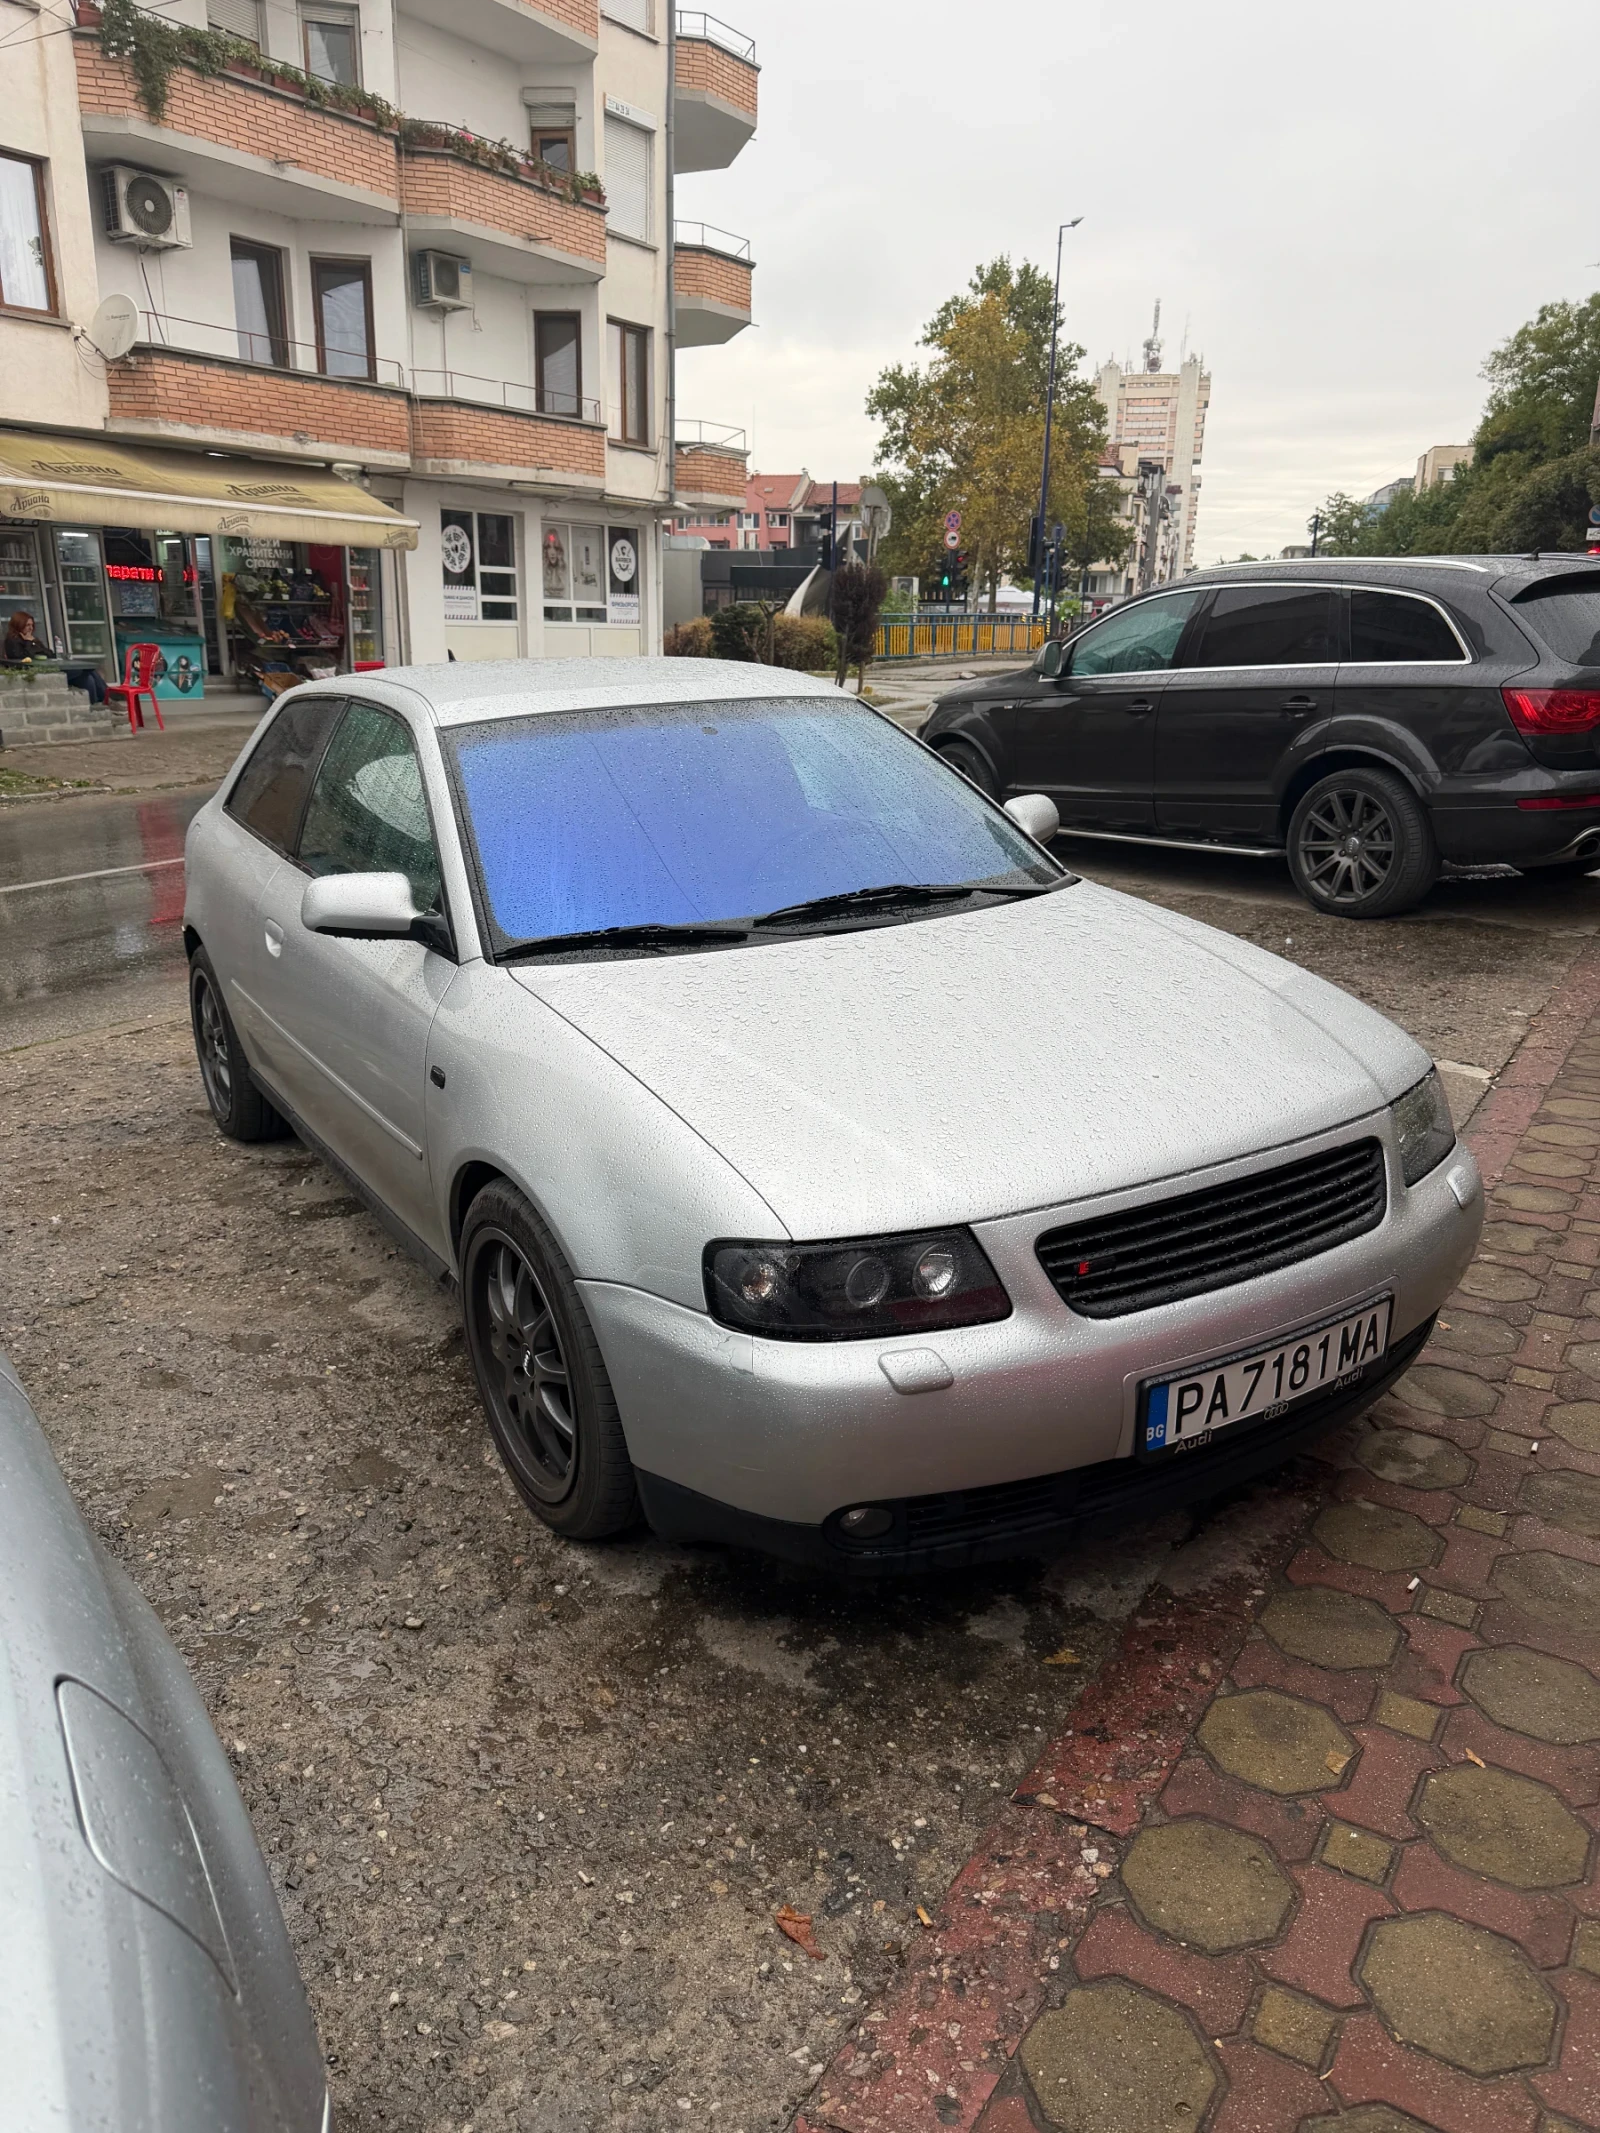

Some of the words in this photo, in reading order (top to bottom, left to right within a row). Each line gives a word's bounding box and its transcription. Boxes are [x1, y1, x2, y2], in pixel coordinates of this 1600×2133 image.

[31, 459, 122, 475] Ариана
[225, 484, 300, 497] Ариана
[11, 495, 50, 512] Ариана
[217, 515, 249, 531] Ариана
[229, 546, 294, 559] ХРАНИТЕЛНИ
[245, 558, 280, 569] СТОКИ
[1333, 1365, 1364, 1391] Audi
[1146, 1423, 1165, 1442] BG
[1174, 1429, 1213, 1454] Audi
